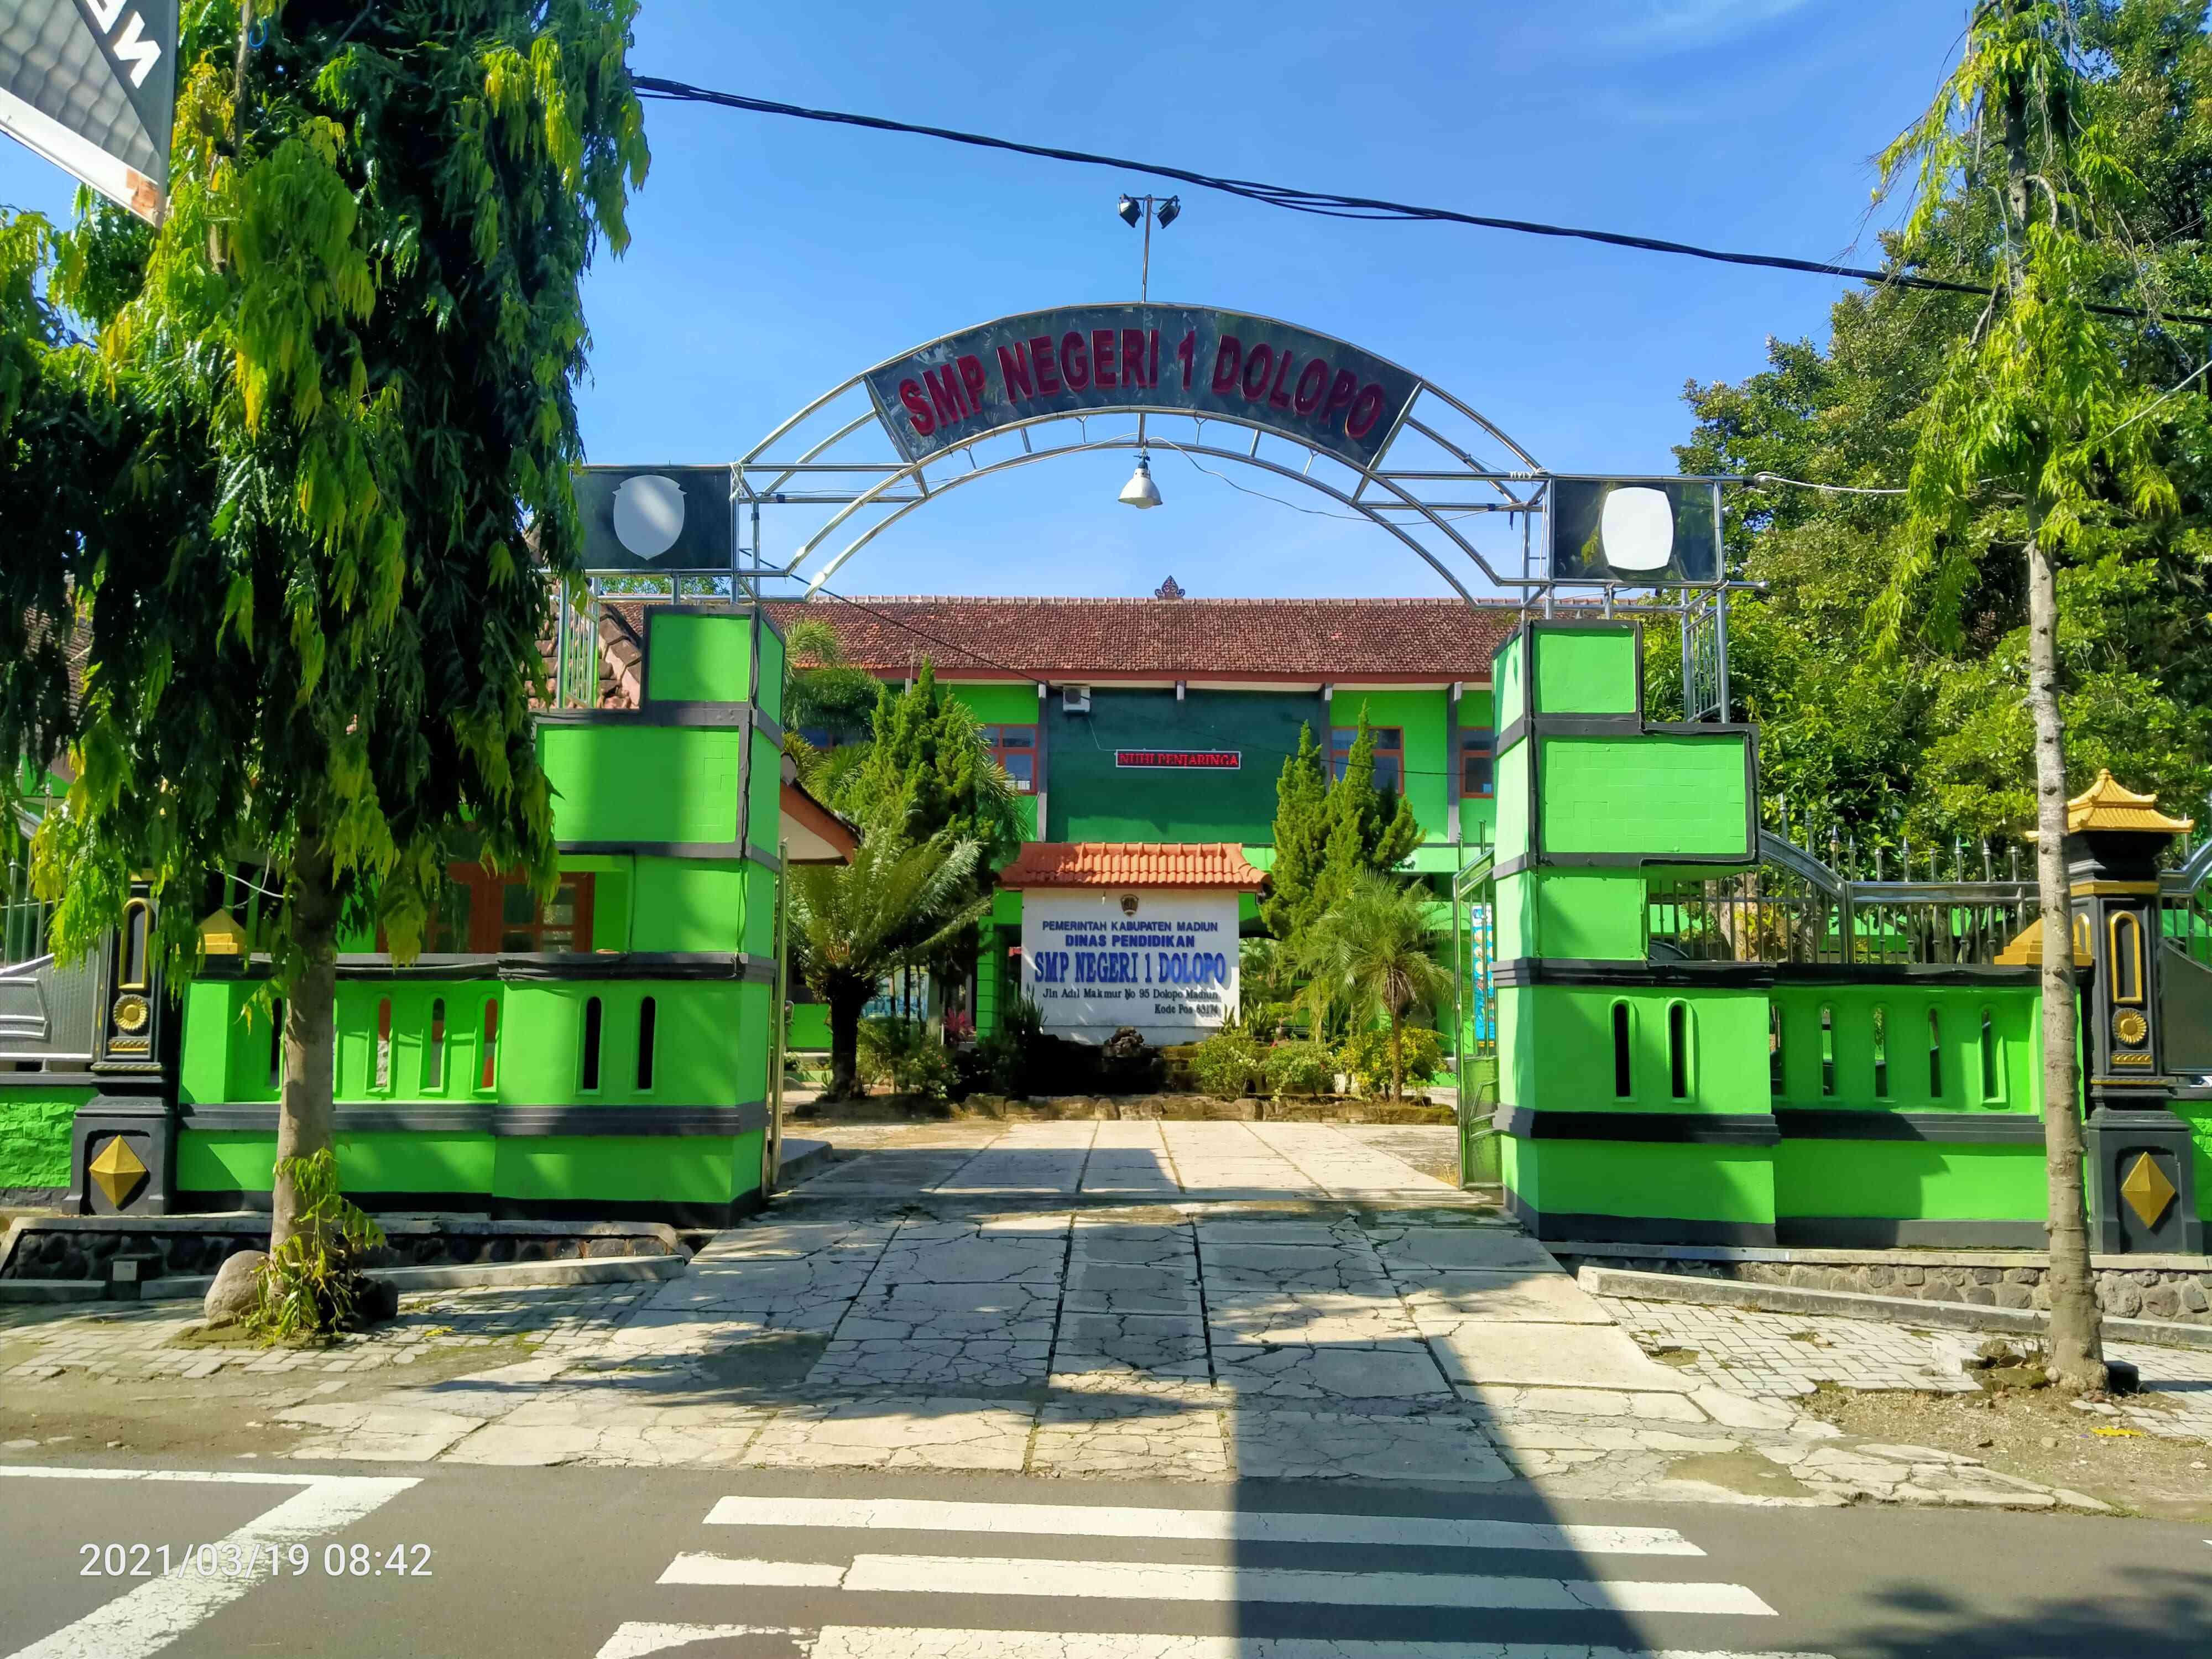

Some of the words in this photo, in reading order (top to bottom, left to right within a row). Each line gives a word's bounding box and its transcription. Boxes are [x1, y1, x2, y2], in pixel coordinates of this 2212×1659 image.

[899, 353, 986, 438] SMP
[997, 328, 1159, 404] NEGERI
[1178, 331, 1197, 391] 1
[1212, 334, 1386, 440] DOLOPO
[1042, 921, 1107, 931] PEMERINTAH
[1111, 921, 1172, 932] KABUPATEN
[1177, 921, 1218, 932] MADIUN
[1065, 935, 1107, 947] DINAS
[1112, 935, 1194, 947] PENDIDIKAN
[1035, 952, 1069, 983] SMP
[1074, 952, 1138, 983] NEGERI
[1145, 952, 1151, 983] 1
[1159, 952, 1226, 984] DOLOPO
[1043, 988, 1058, 998] Jln
[1061, 988, 1080, 998] Adil
[1084, 988, 1122, 998] Makmur
[1139, 988, 1150, 998] 95
[1154, 988, 1183, 1001] Dolopo
[1186, 989, 1218, 999] Madiun
[1155, 1004, 1176, 1014] Kode
[1178, 1004, 1193, 1014] Pos
